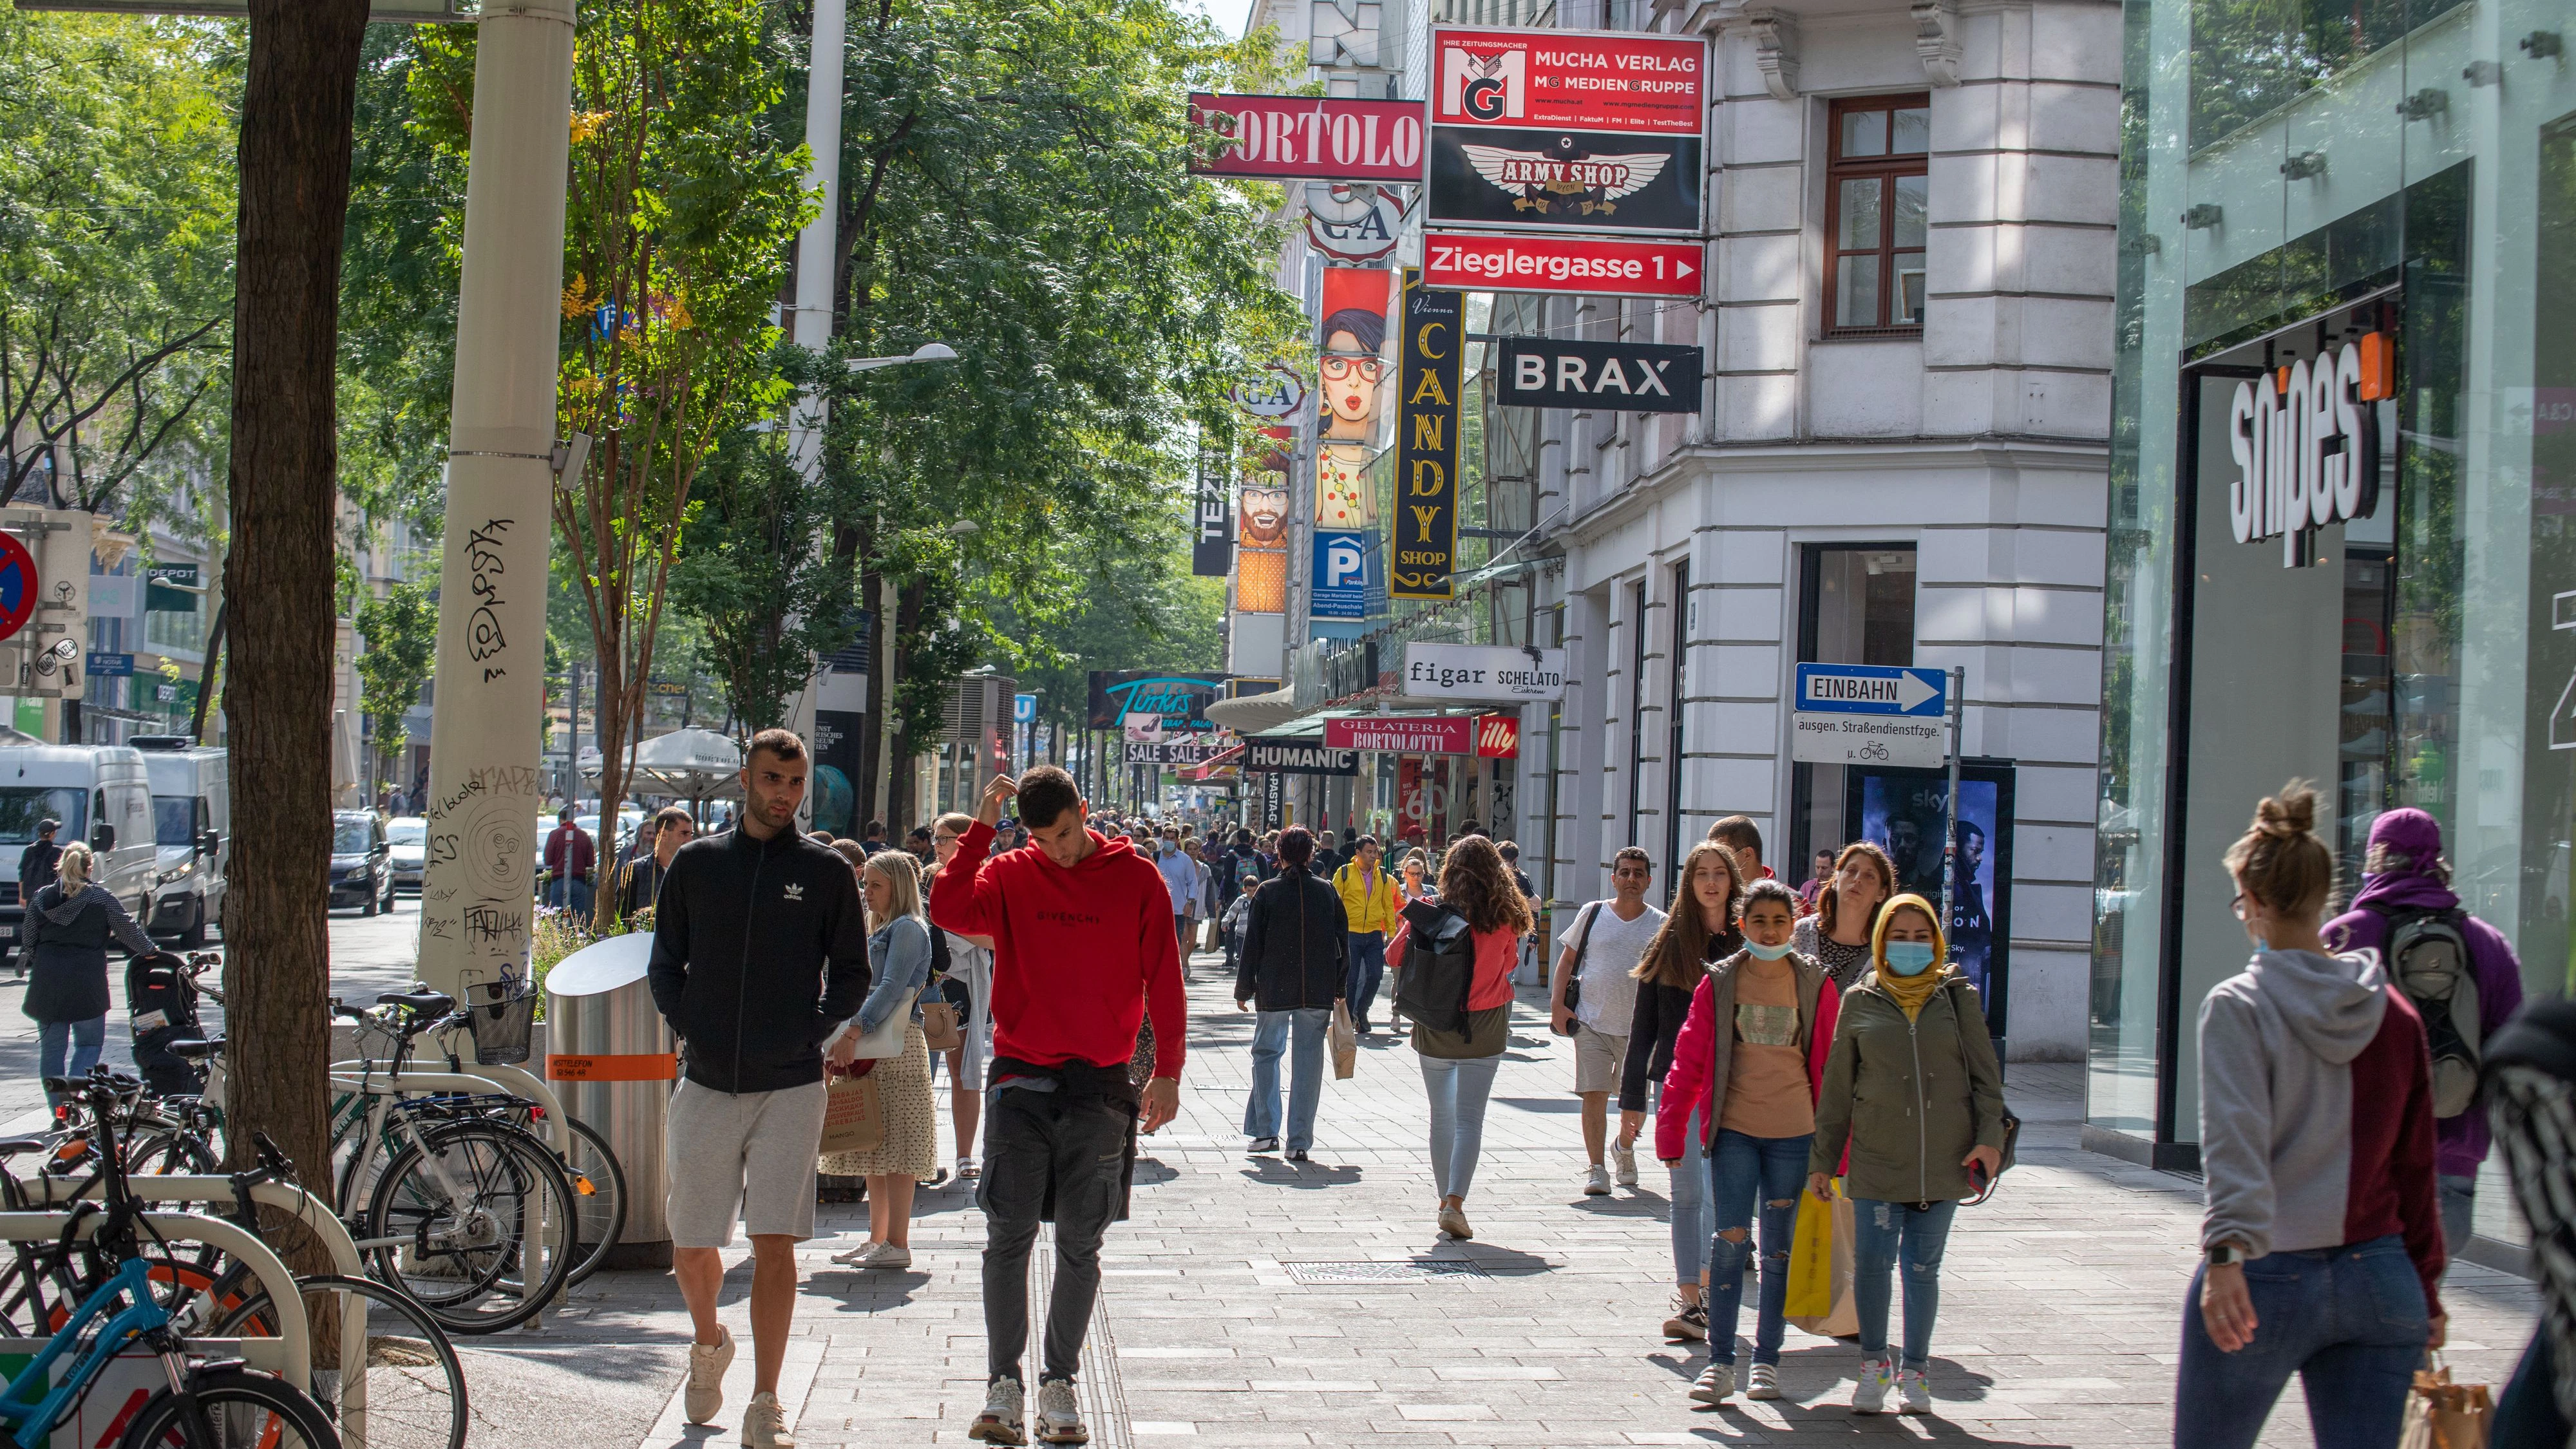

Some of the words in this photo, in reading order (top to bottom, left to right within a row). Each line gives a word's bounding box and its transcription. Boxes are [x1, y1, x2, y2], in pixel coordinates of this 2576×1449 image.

[1462, 41, 1528, 49] ZEITUNGSMACHER
[1535, 51, 1608, 68] MUCHA
[1615, 55, 1695, 72] VERLAG
[1535, 76, 1559, 88] MG
[1566, 78, 1694, 94] MEDIENGRUPPE
[1603, 101, 1694, 110] www.mgmediengruppe.com
[1505, 161, 1566, 182] ARMY
[1571, 164, 1628, 185] SHOP
[1430, 247, 1643, 280] Zieglergasse
[1652, 256, 1664, 279] 1
[1412, 295, 1454, 314] Vienna
[1515, 354, 1671, 396] BRAX
[1408, 323, 1451, 543] CANDY
[2230, 342, 2362, 568] snipes
[1401, 551, 1446, 566] SHOP
[148, 569, 196, 578] DEPOT
[1410, 662, 1486, 688] figar
[1498, 671, 1559, 687] SCHELATO
[1814, 678, 1898, 701] EINBAHN
[1014, 701, 1030, 719] U
[1106, 677, 1217, 726] Türkis
[1340, 721, 1457, 734] GELATERIA
[1481, 721, 1515, 754] illy
[1799, 721, 1839, 733] ausgen.
[1842, 721, 1940, 739] Straßendienstfzge.
[1353, 732, 1443, 752] BORTOLOTTI
[1129, 744, 1160, 762] SALE
[1170, 746, 1200, 763] SALE
[1253, 746, 1351, 768] HUMANIC
[1912, 790, 1949, 813] sky
[829, 1131, 855, 1140] MANGO
